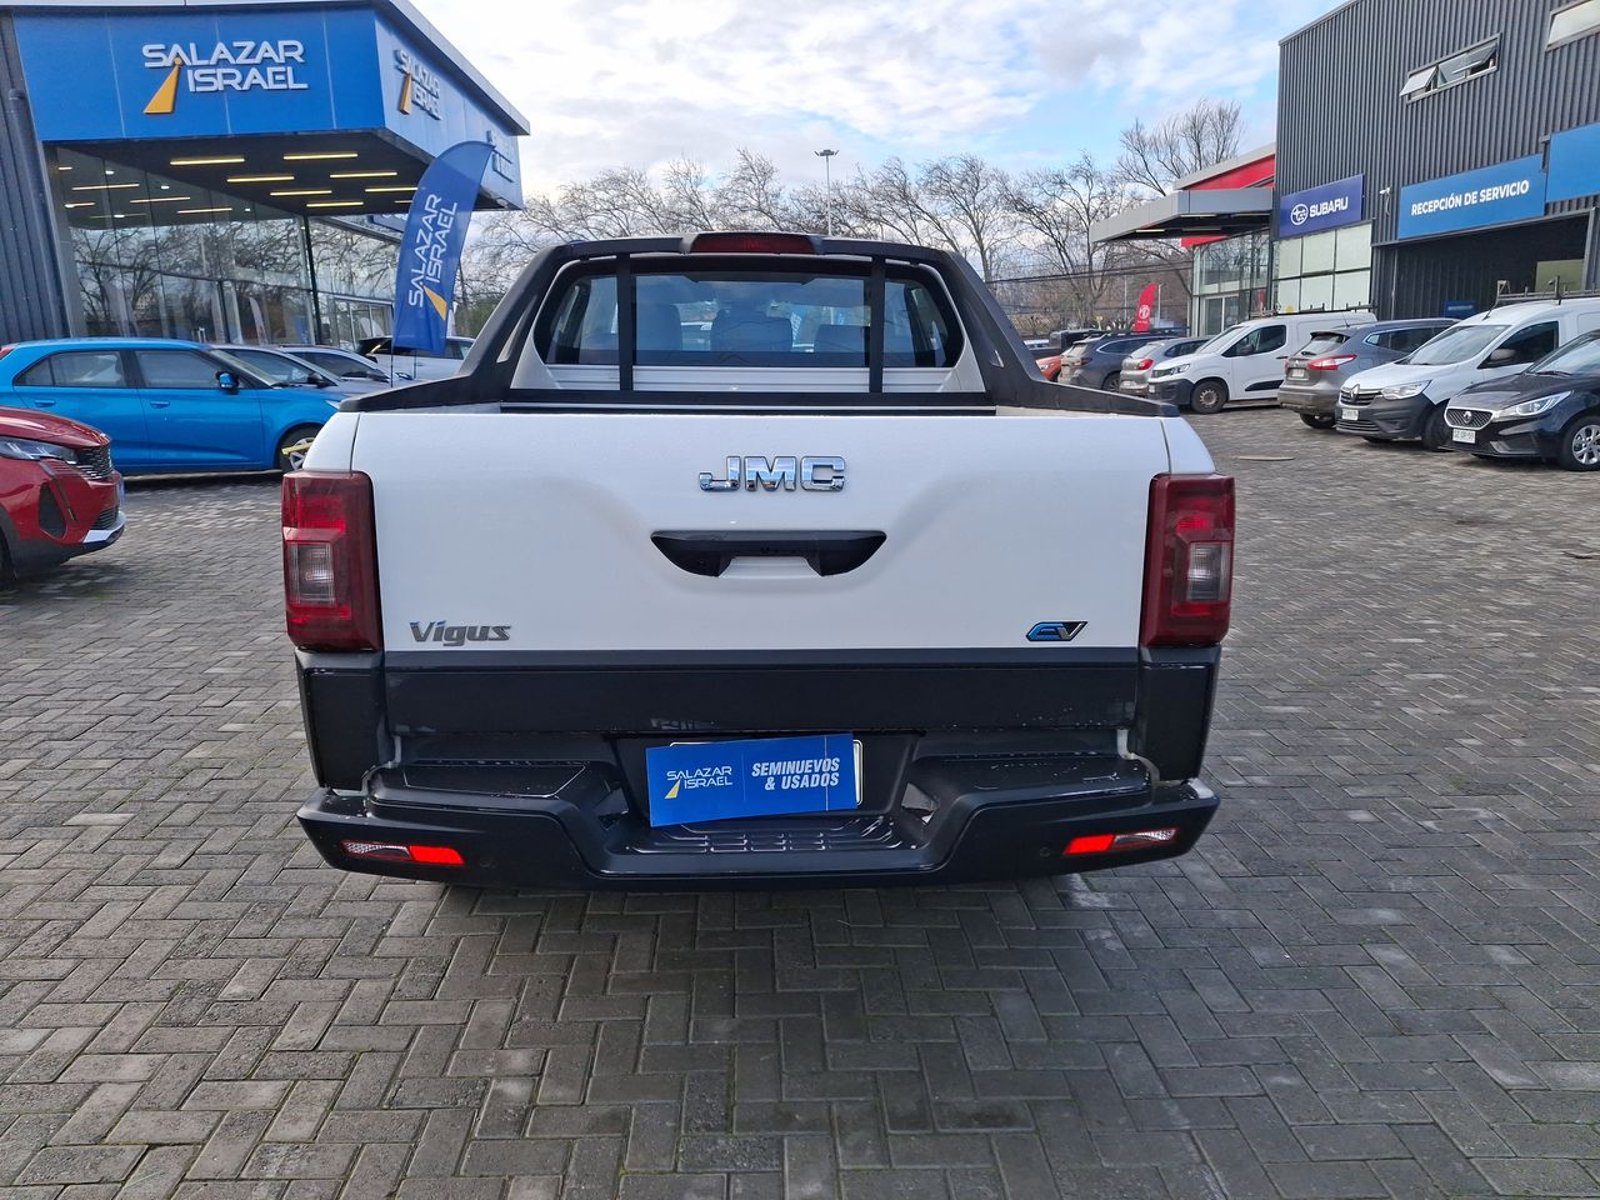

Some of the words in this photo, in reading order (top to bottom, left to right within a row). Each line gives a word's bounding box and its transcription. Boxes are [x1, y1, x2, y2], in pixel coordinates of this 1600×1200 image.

[142, 40, 305, 68] SALAZAR
[187, 66, 309, 92] ISRAEL
[1309, 196, 1349, 218] SUBARU
[1411, 193, 1463, 216] RECEPCIÓN
[1464, 191, 1478, 206] DE
[1480, 179, 1530, 203] SERVICIO
[408, 194, 442, 307] SALAZAR
[425, 202, 458, 283] ISRAEL
[698, 455, 846, 493] JMC
[409, 620, 512, 647] Vigus
[1025, 620, 1088, 642] EV
[666, 765, 732, 781] SALAZAR
[751, 757, 840, 777] SEMINUEVOS
[684, 776, 733, 790] ISRAEL
[764, 777, 776, 791] &
[781, 772, 840, 790] USADOS
